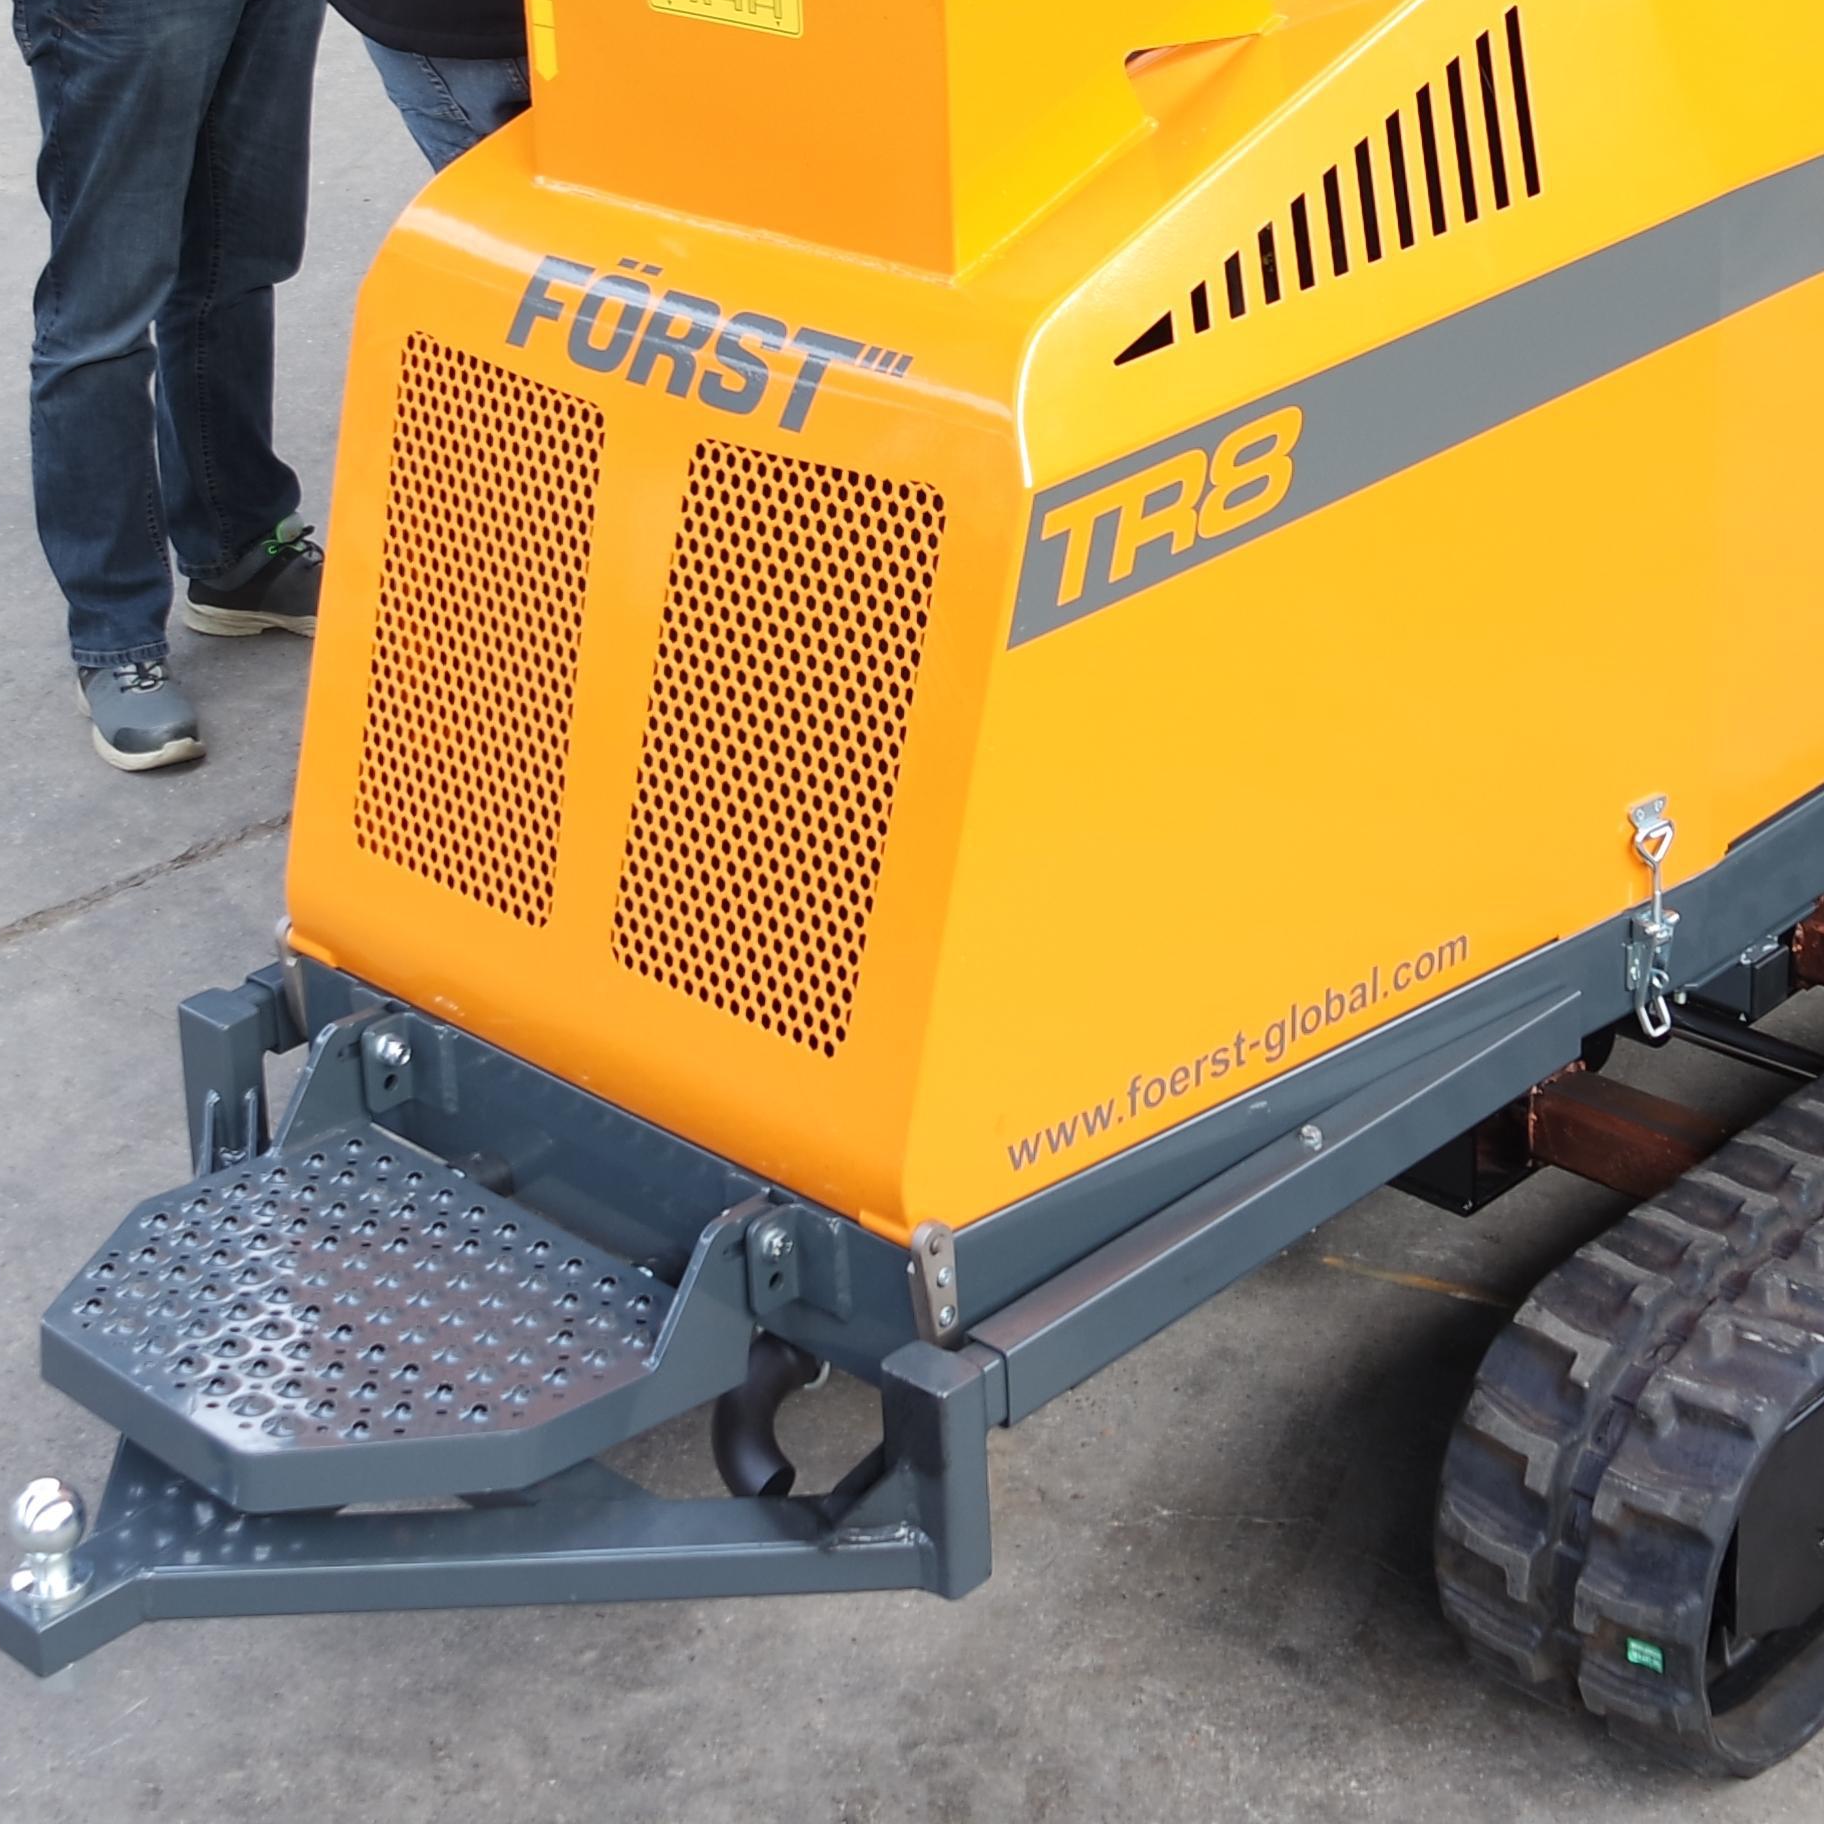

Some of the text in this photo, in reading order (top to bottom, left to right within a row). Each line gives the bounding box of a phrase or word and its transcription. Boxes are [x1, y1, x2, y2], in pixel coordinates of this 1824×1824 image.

[505, 255, 866, 433] FÖRST
[1040, 404, 1303, 607] TR8
[1006, 933, 1469, 1172] www.foerst-global.com
